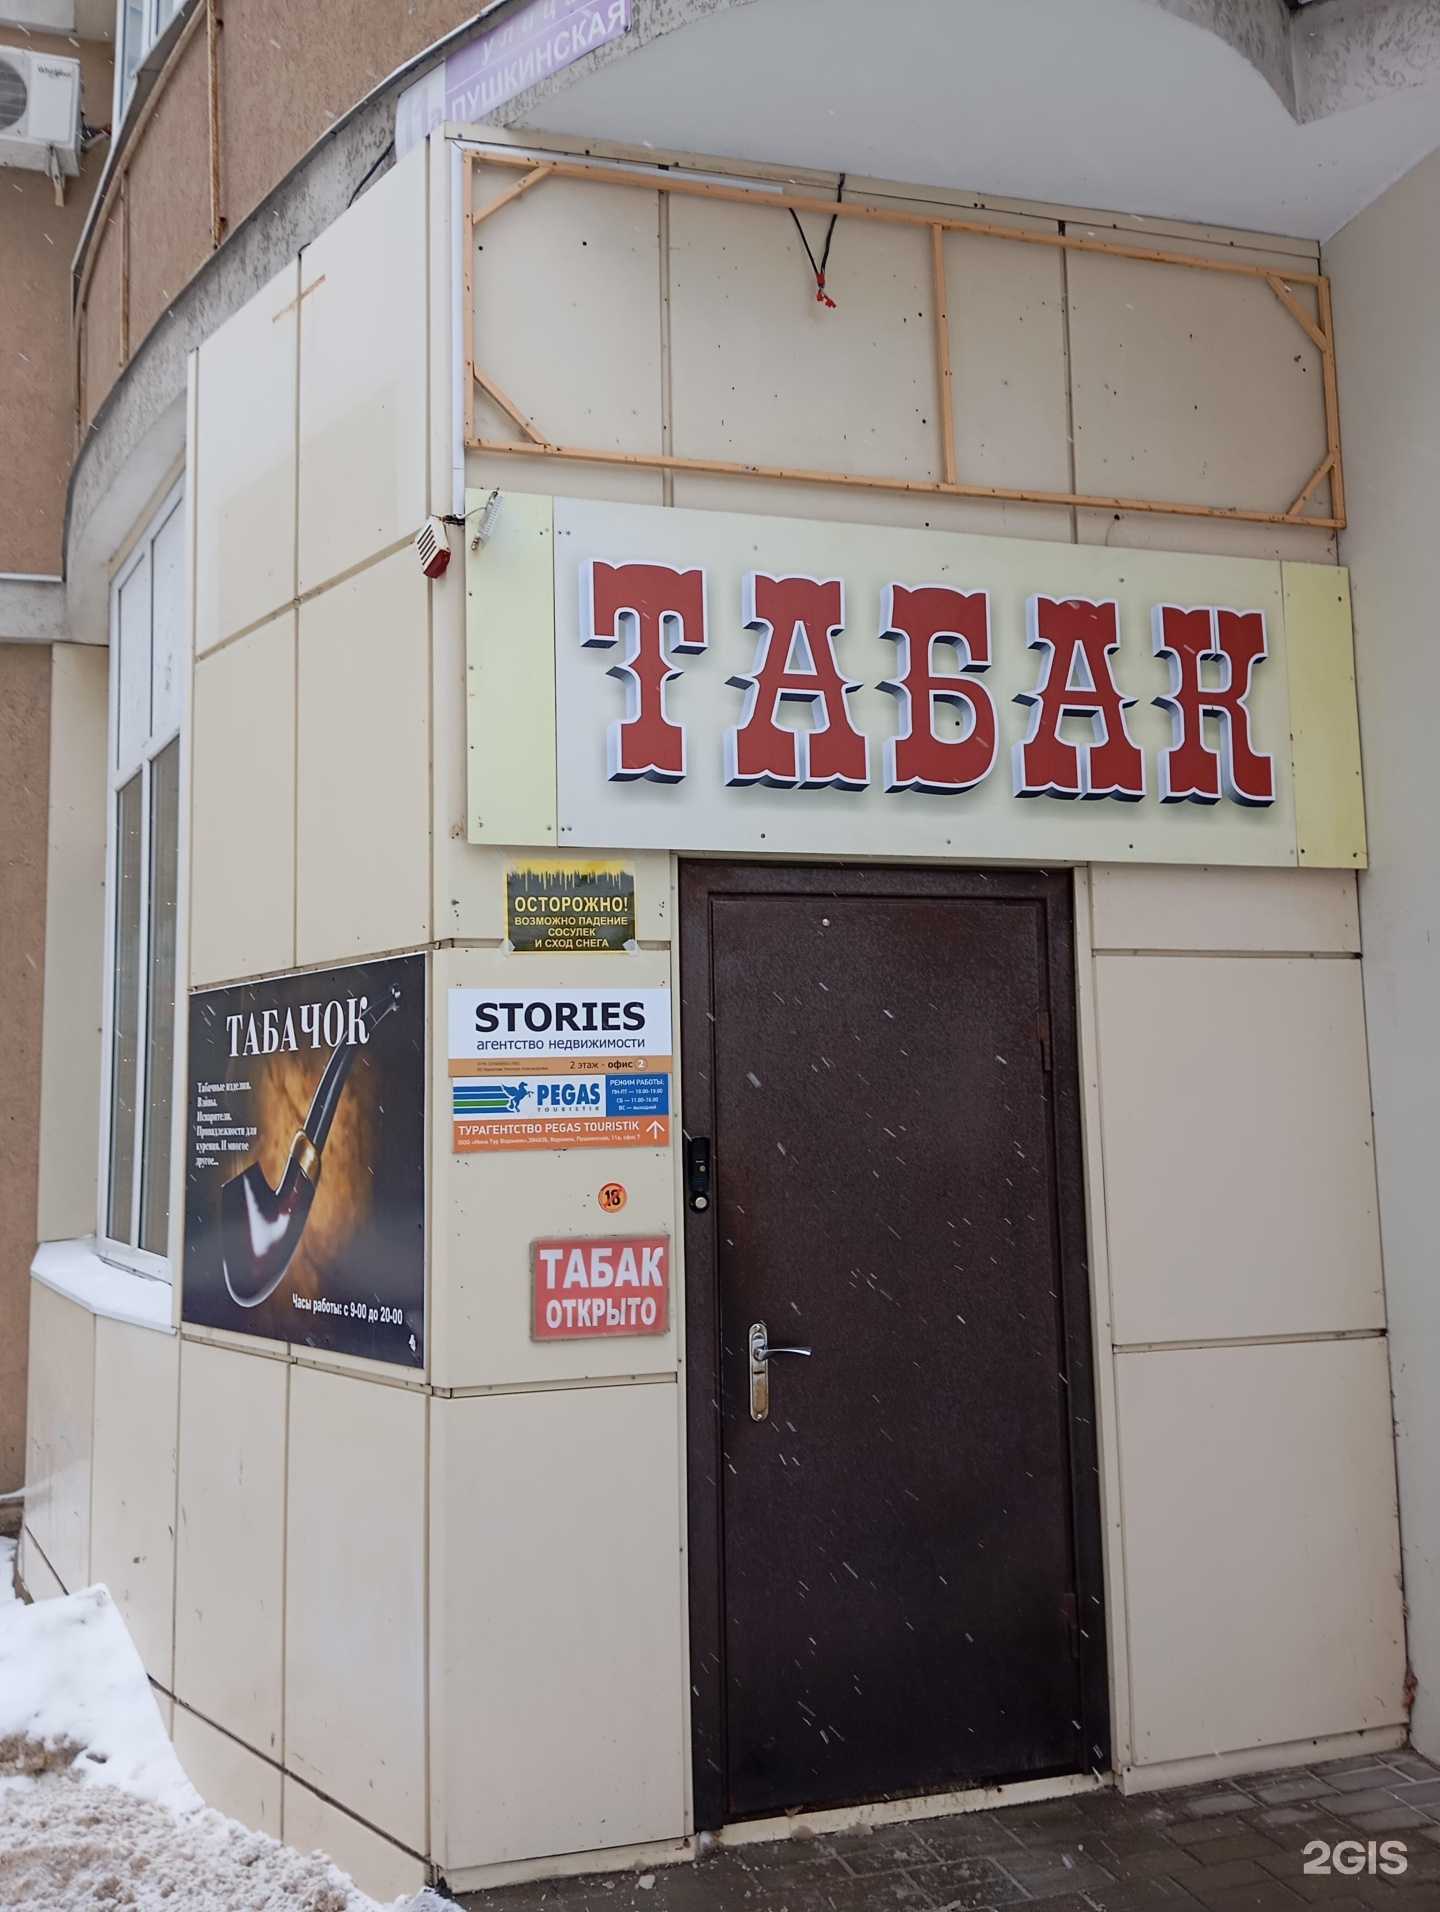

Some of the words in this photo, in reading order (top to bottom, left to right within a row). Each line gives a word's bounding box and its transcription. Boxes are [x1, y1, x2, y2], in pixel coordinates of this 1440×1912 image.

[451, 1, 625, 121] ПУШКИНСКАЯ
[580, 559, 1275, 806] ТАБАК
[514, 896, 628, 912] ОСТОРОЖНО!
[514, 917, 576, 926] ВОЗМОЖНО
[578, 917, 628, 926] ПАДЕНИЕ
[548, 928, 596, 937] СОСУЛЕК
[535, 939, 542, 948] И
[545, 938, 573, 949] СХОД
[576, 938, 609, 948] СНЕГА
[226, 996, 370, 1057] ТАБАЧОК
[475, 1002, 646, 1032] STORIES
[476, 1040, 544, 1050] агентство
[549, 1038, 645, 1050] недвижимости
[570, 1061, 576, 1069] 2
[577, 1062, 599, 1070] этаж
[607, 1060, 633, 1071] офис
[536, 1082, 601, 1105] PEGAS
[458, 1124, 542, 1135] ТУРАГЕНТСТВО
[545, 1122, 581, 1133] PEGAS
[584, 1121, 640, 1132] TOURISTIK
[539, 1246, 664, 1290] ТАБАК
[292, 1293, 312, 1310] Часы
[312, 1297, 342, 1316] работы:
[343, 1304, 349, 1317] с
[350, 1302, 367, 1320] 9-00
[368, 1309, 379, 1323] до
[380, 1306, 403, 1325] 20-00
[545, 1296, 657, 1329] ОТКРЫТО
